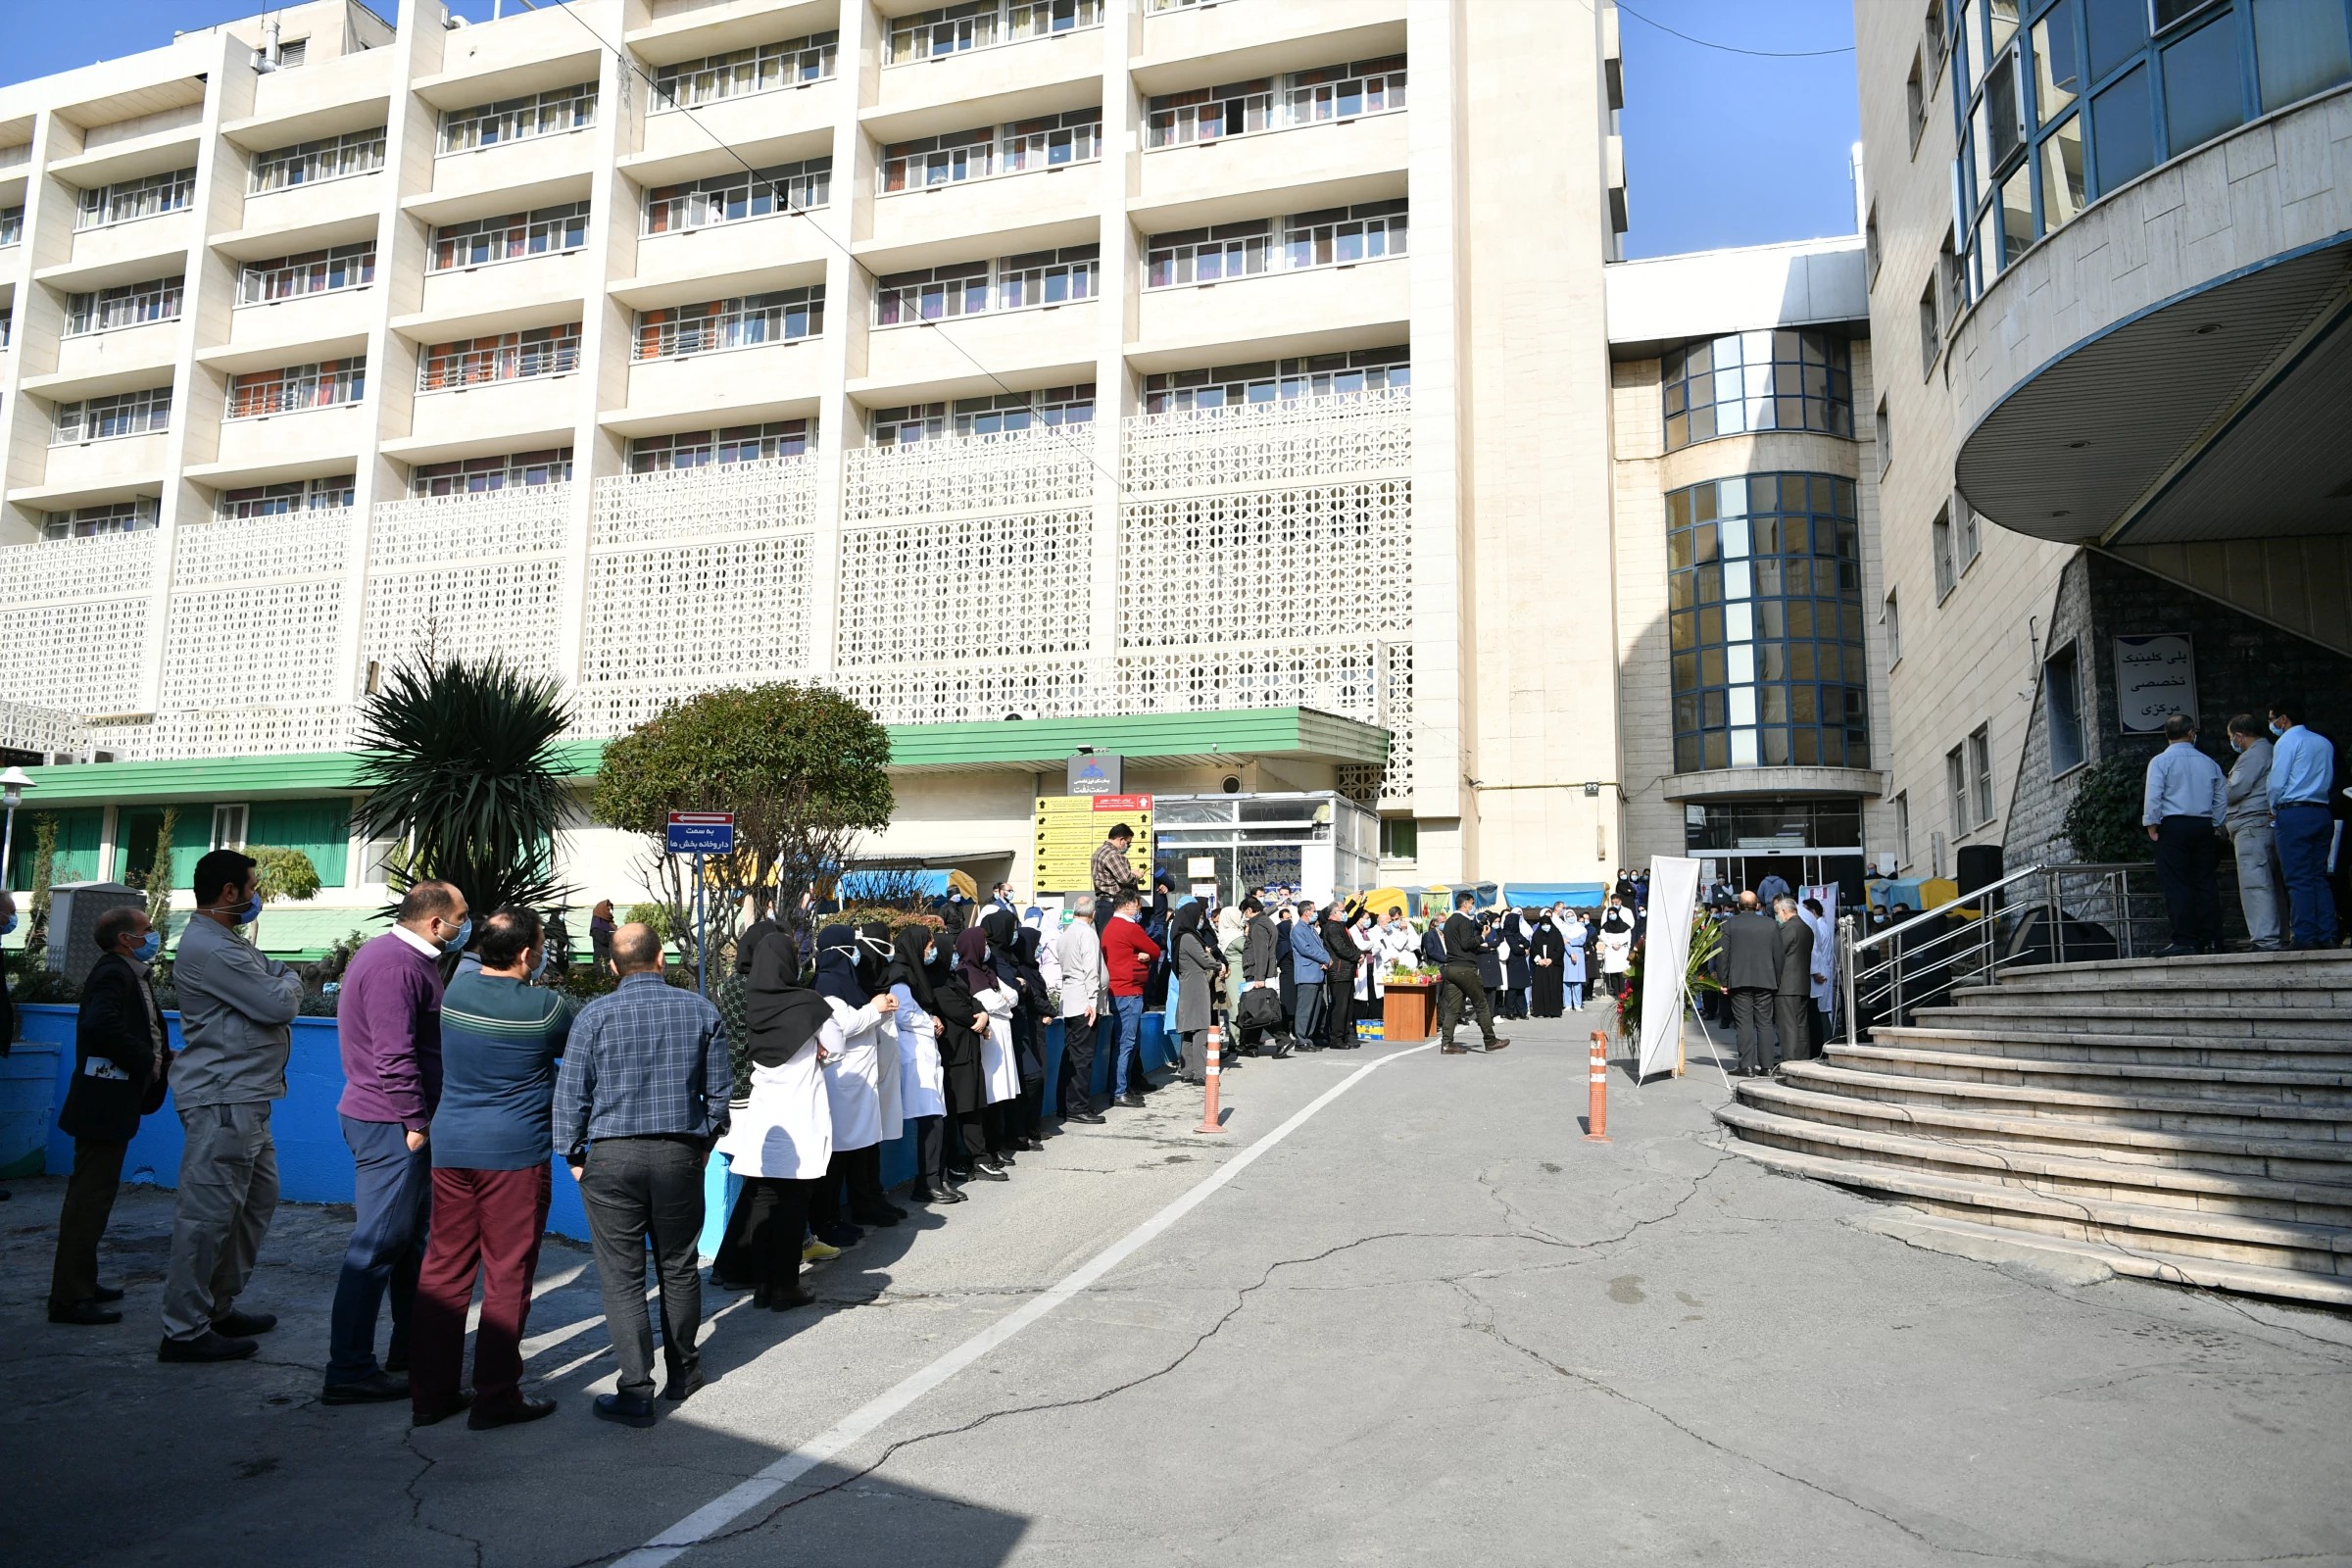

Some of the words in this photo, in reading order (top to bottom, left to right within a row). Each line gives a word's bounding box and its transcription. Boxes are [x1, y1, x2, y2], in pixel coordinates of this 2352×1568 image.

[2123, 652, 2162, 666] کلینیک
[2167, 651, 2187, 664] پلی
[2131, 676, 2186, 692] تخصصی
[2141, 704, 2180, 715] مرکزی
[679, 840, 698, 849] بخش
[699, 841, 729, 850] داروخانه
